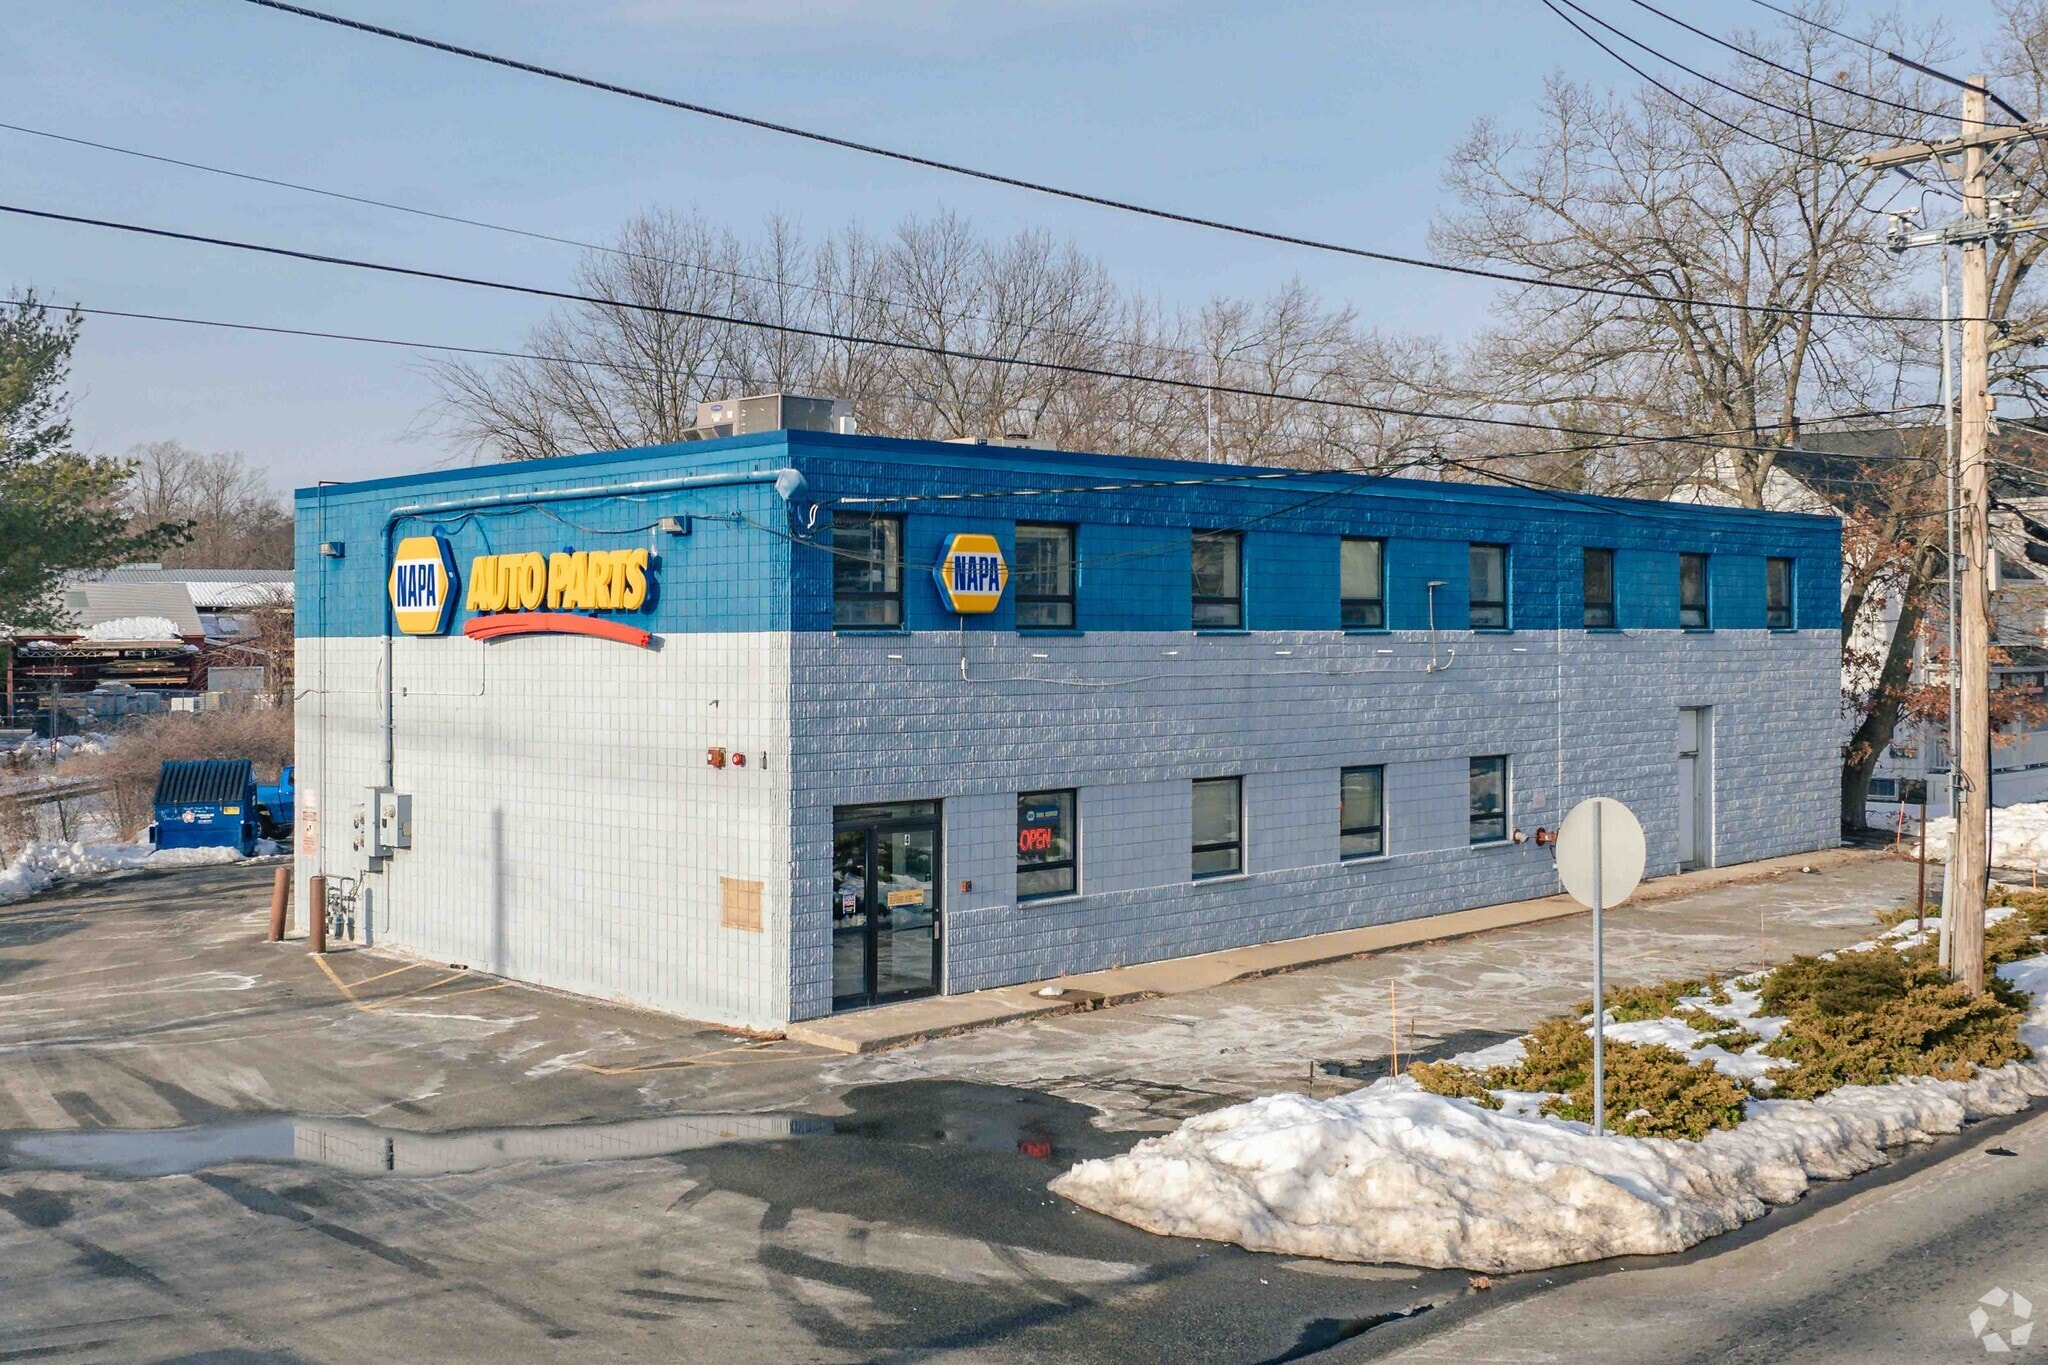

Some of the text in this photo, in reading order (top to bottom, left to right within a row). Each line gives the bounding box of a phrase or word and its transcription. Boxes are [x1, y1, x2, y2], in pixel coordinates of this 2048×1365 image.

[396, 563, 437, 607] NAPA
[466, 548, 649, 611] AUTO PARTS
[954, 555, 1000, 592] NAPA
[1020, 828, 1052, 851] OPEN
